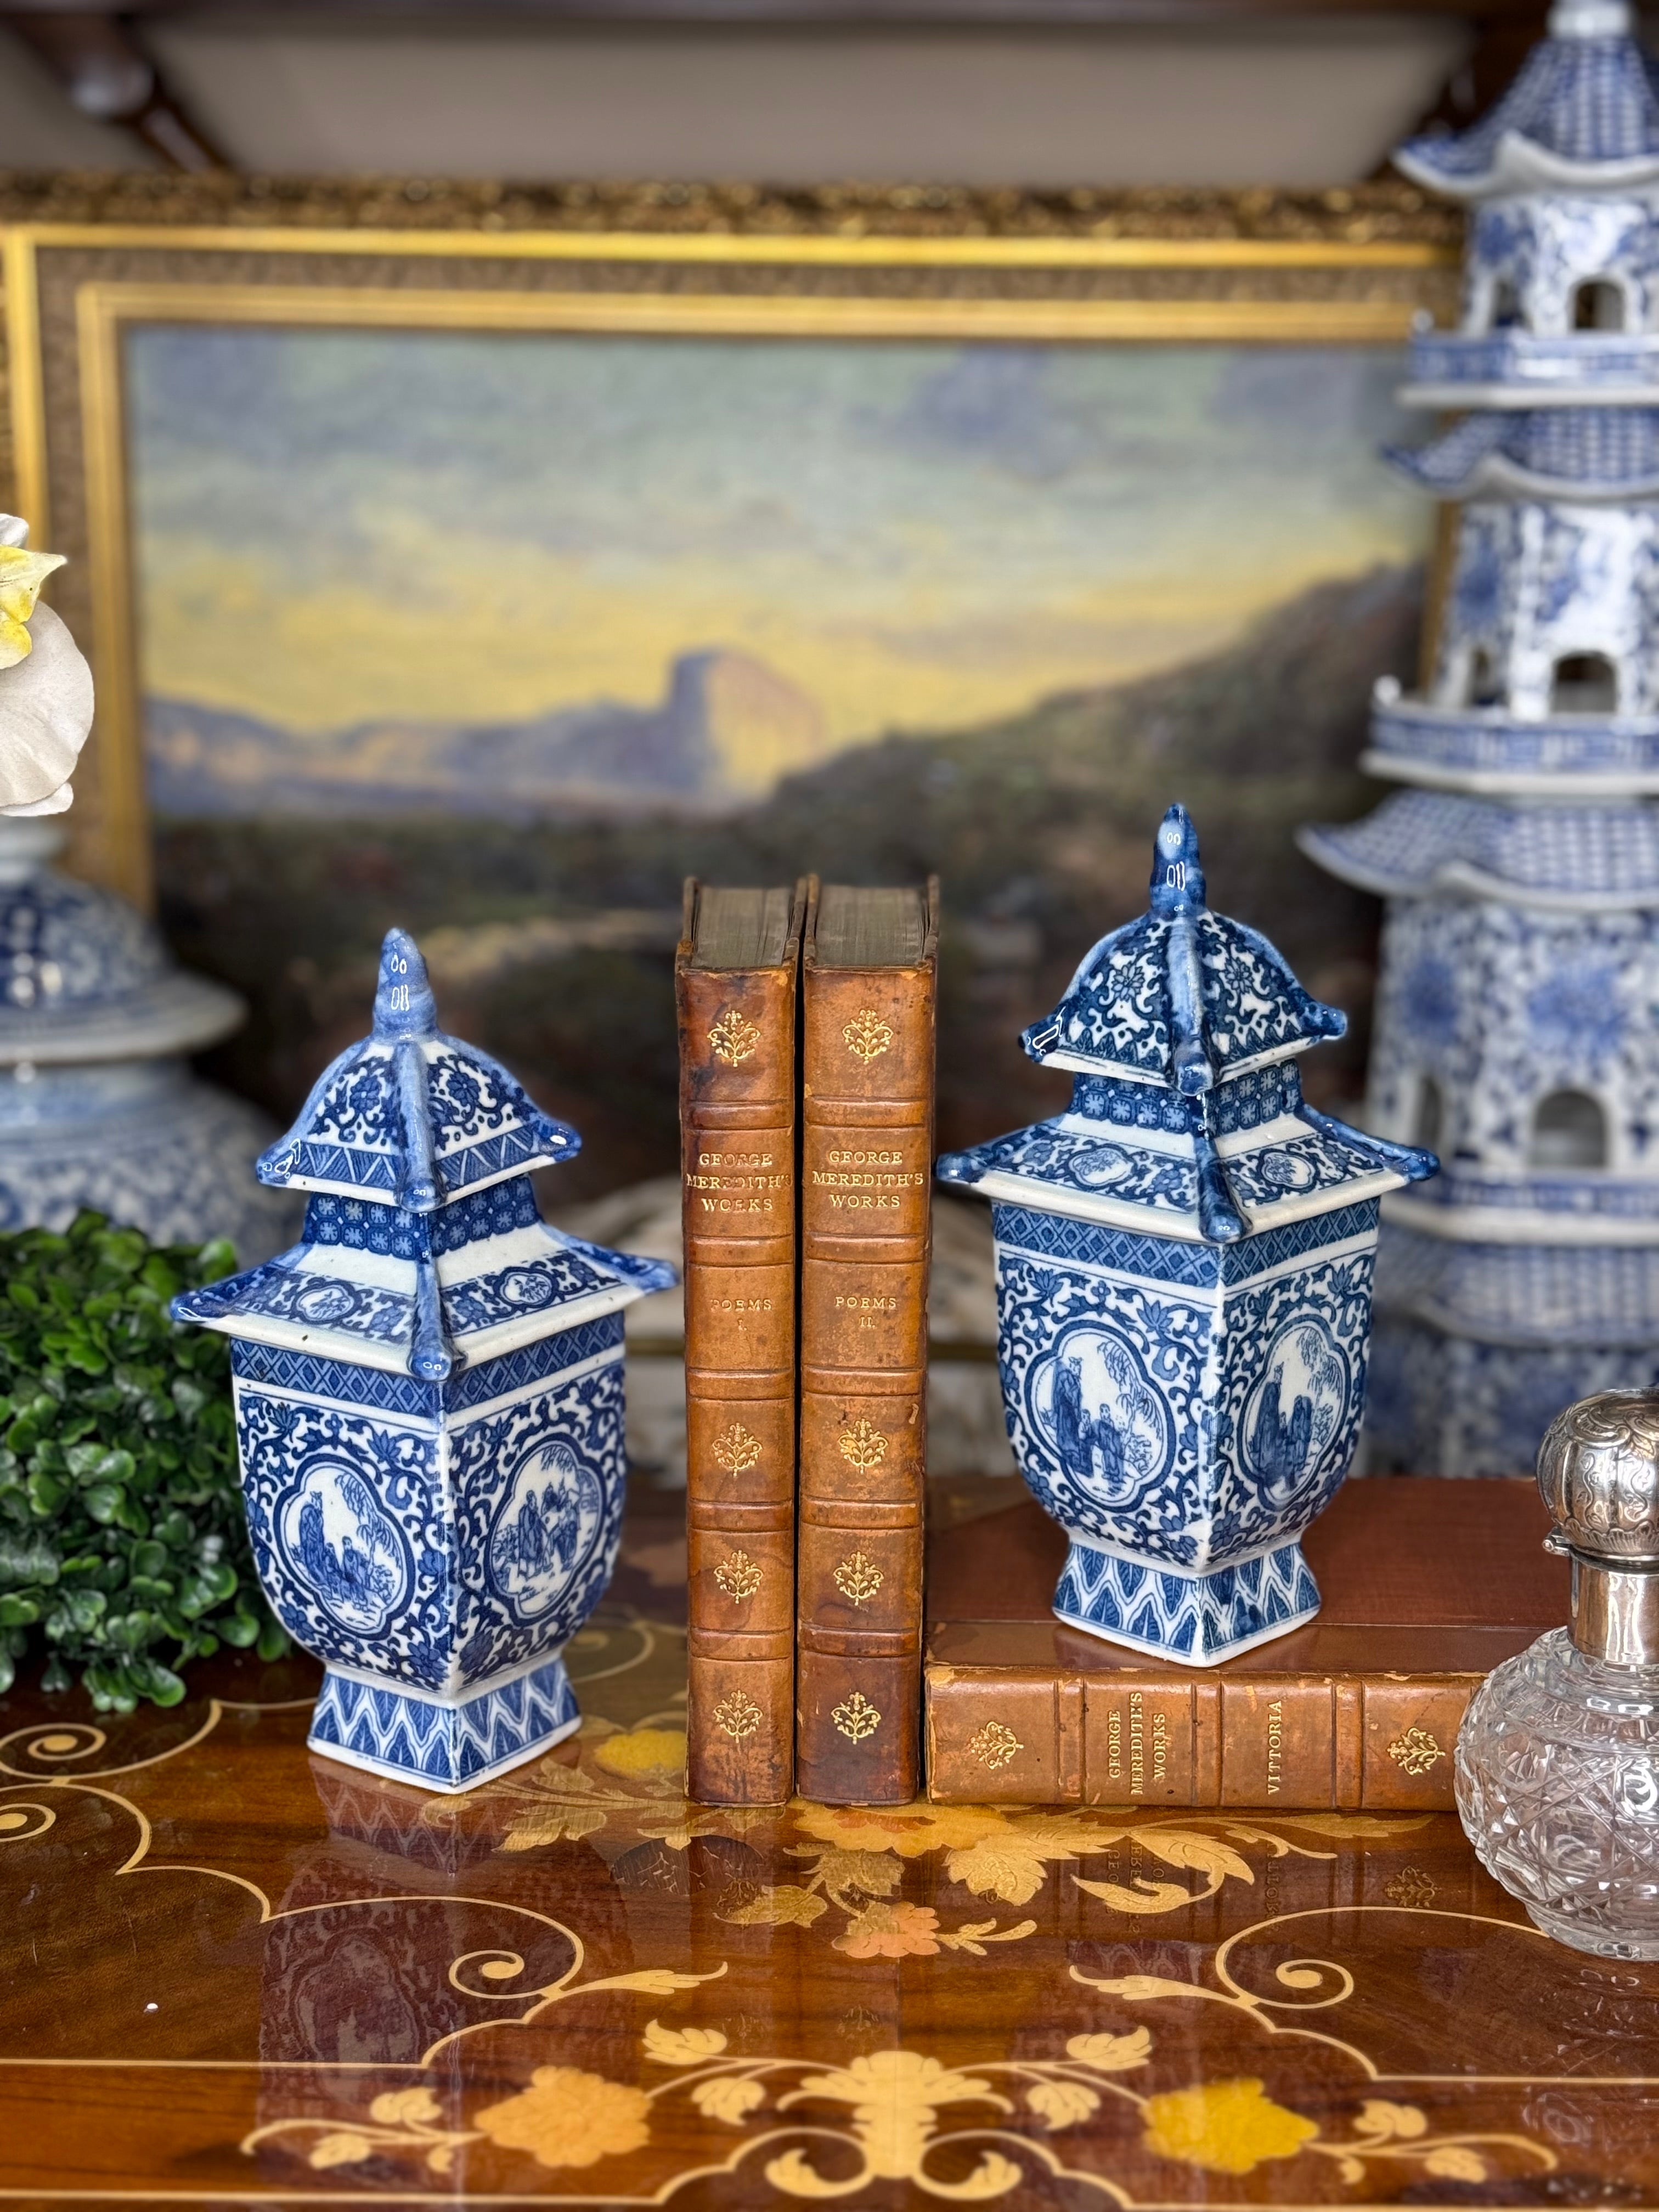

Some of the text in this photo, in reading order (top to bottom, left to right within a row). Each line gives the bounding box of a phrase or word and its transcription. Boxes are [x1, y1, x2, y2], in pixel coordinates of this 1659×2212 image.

[699, 1153, 773, 1167] GEORGE
[829, 1150, 903, 1164] GEORGE
[812, 1171, 924, 1187] MEREDITH'S
[701, 1198, 774, 1212] WORKS
[829, 1194, 900, 1208] WORKS
[710, 1299, 771, 1312] POEMS
[835, 1296, 896, 1309] POEMS
[860, 1316, 876, 1328] II.
[1108, 1710, 1121, 1779] GEORGE
[1130, 1692, 1143, 1795] MEREDITH'S
[1153, 1713, 1166, 1779] WORKS
[1267, 1700, 1282, 1795] VITTORIA
